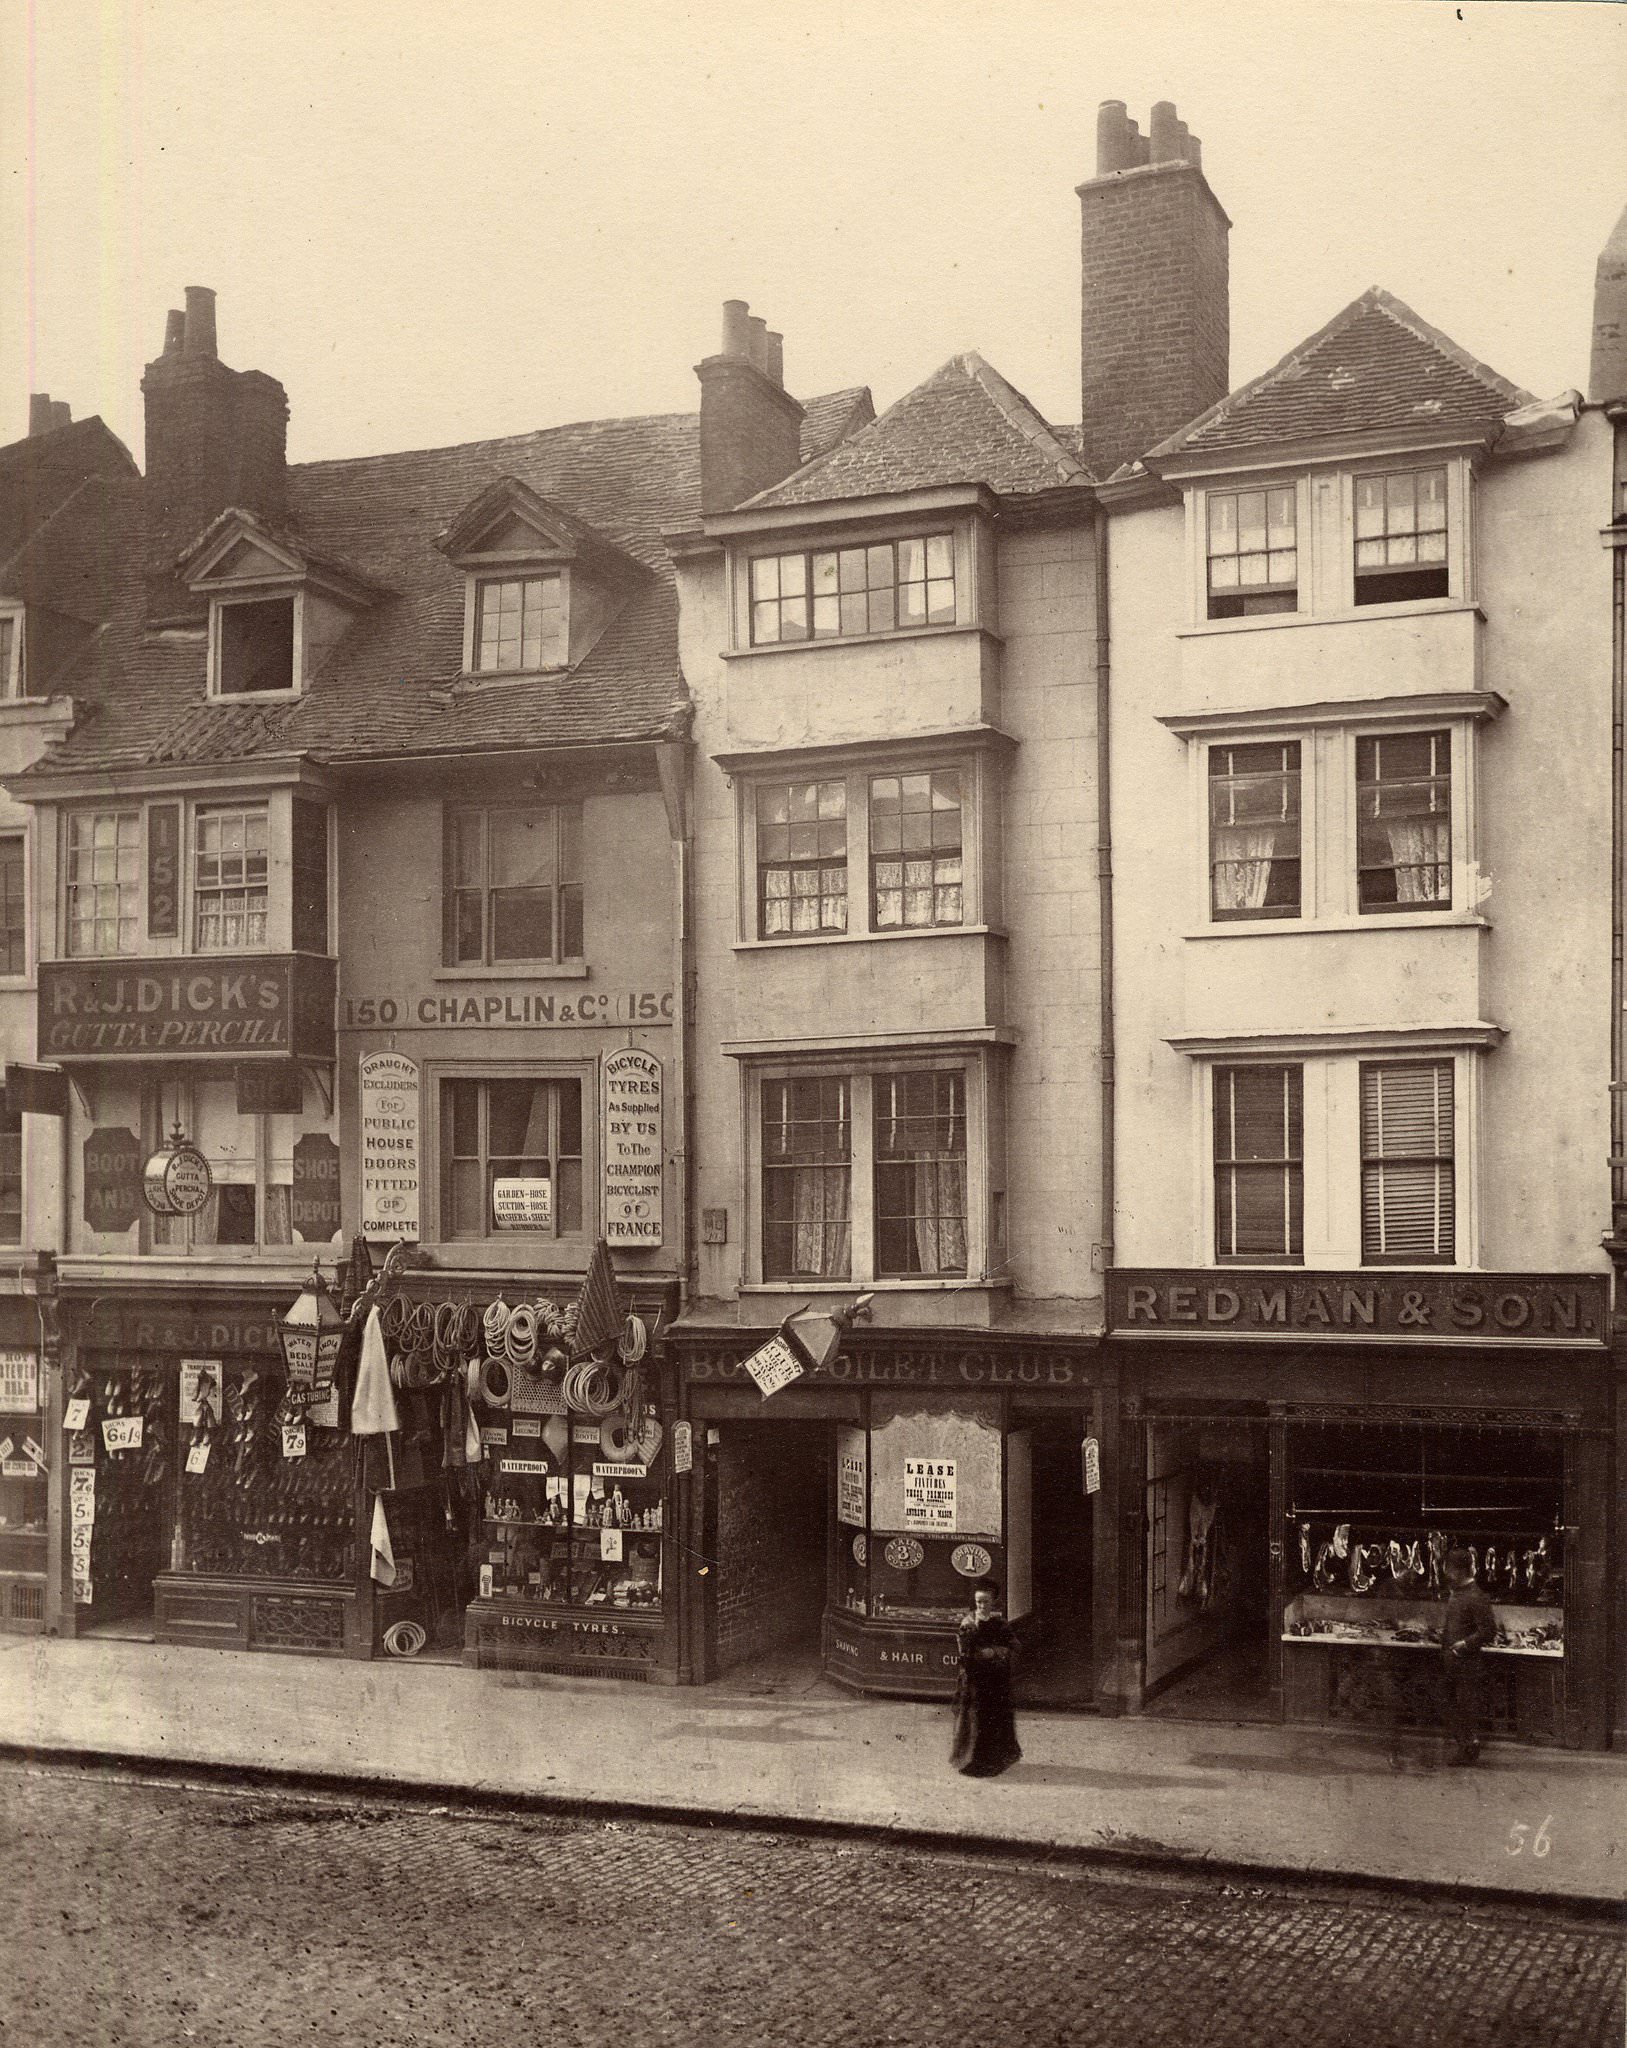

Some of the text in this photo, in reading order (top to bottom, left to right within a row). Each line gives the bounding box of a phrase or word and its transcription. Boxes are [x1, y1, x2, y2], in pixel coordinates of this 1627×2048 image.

[154, 819, 175, 924] 152
[417, 996, 554, 1023] CHAPLIN
[559, 1005, 576, 1021] &
[363, 1058, 418, 1076] DRAUGHT
[607, 1056, 658, 1076] BICYCLE
[363, 1079, 418, 1091] EXCLUDERS
[608, 1080, 660, 1094] TYRES
[608, 1102, 660, 1115] As Supplied
[364, 1117, 415, 1130] PUBLIC
[610, 1121, 657, 1135] BY US
[366, 1137, 414, 1150] HOUSE
[617, 1143, 651, 1155] To The
[87, 1152, 138, 1173] BOOT
[295, 1159, 339, 1179] SHOE
[364, 1157, 416, 1170] DOORS
[176, 1172, 199, 1181] GUTTA
[607, 1163, 661, 1177] CHAMPION
[176, 1184, 199, 1192] PERCHA
[366, 1178, 418, 1191] FITTED
[607, 1184, 660, 1197] BICYCLIST
[169, 1188, 184, 1208] SHOE
[186, 1189, 205, 1209] DEPOT
[383, 1199, 400, 1210] UP
[294, 1201, 341, 1222] DEPOT
[624, 1204, 642, 1216] OF
[363, 1219, 418, 1232] COMPLETE
[607, 1221, 661, 1236] FRANCE
[1127, 1286, 1595, 1330] REDMAN & SON.
[163, 1328, 177, 1345] &
[288, 1338, 312, 1348] WATER
[320, 1339, 338, 1352] INDIA
[290, 1352, 312, 1360] BEDS
[771, 1346, 794, 1376] CLUB
[291, 1388, 331, 1405] GAS TUBING
[906, 1463, 954, 1476] LEASE
[915, 1477, 946, 1489] FIXTURES
[888, 1538, 918, 1550] HAIR
[887, 1553, 922, 1567] CUTTING
[954, 1546, 988, 1564] SHAVING
[502, 1616, 558, 1630] BICYCLE
[836, 1640, 858, 1657] SHAVING
[880, 1650, 888, 1661] &
[892, 1652, 924, 1663] HAIR
